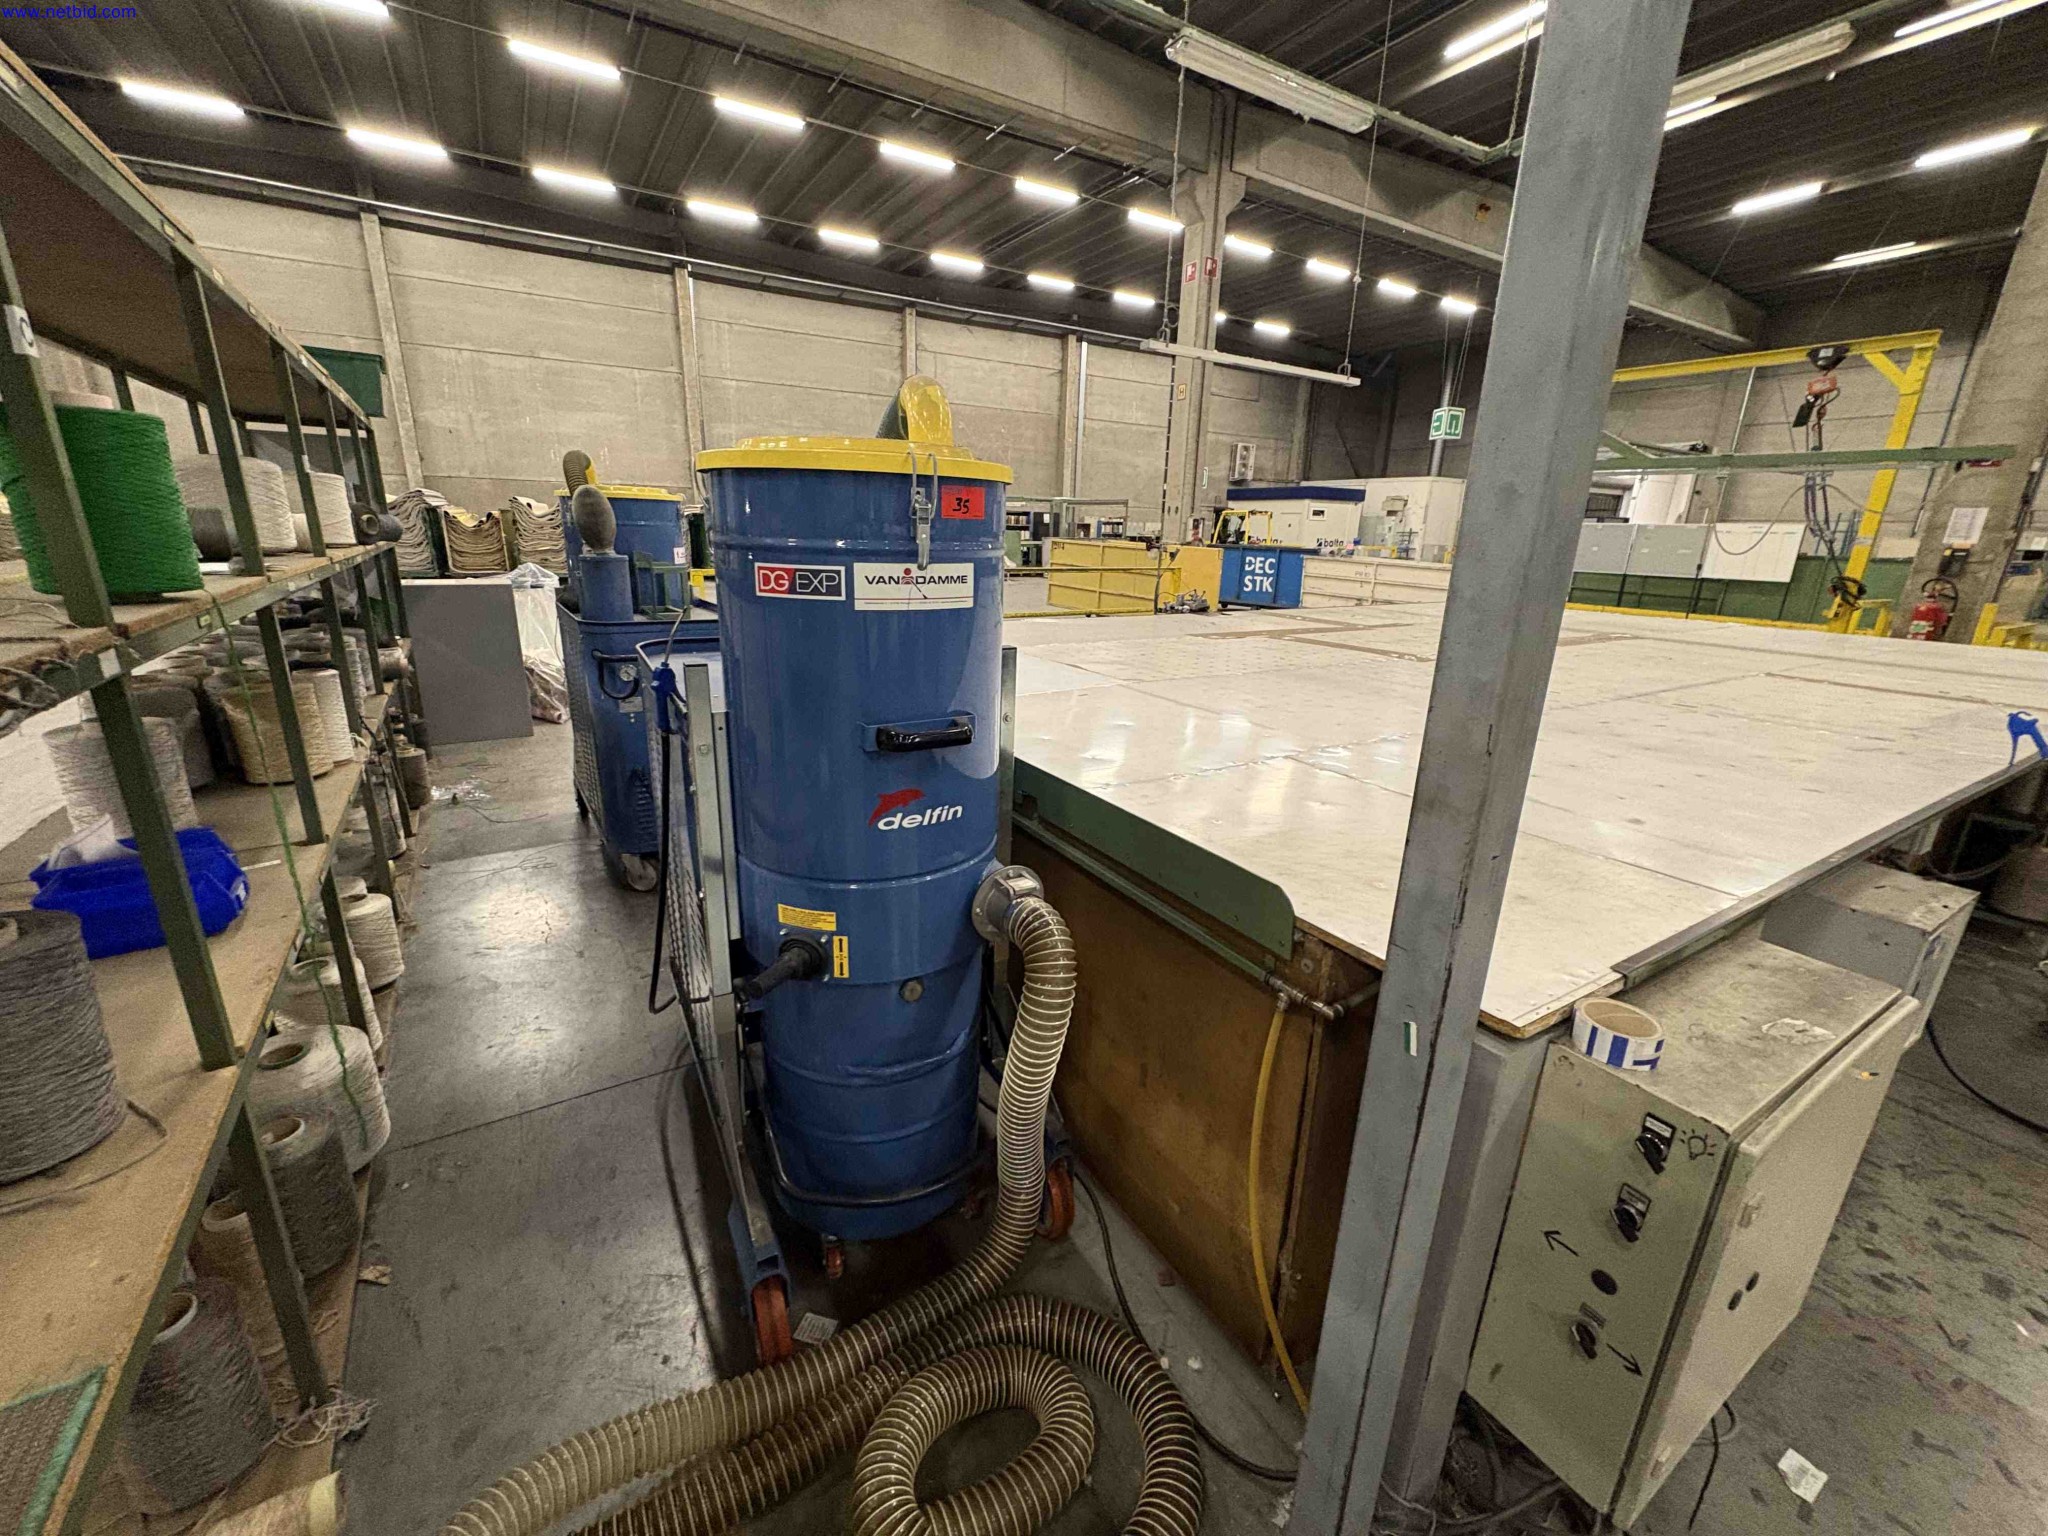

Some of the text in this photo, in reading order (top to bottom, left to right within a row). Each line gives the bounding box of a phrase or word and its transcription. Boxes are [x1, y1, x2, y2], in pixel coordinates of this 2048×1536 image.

[952, 497, 970, 515] 35
[1244, 556, 1276, 574] DEC
[759, 569, 839, 593] DG EXP
[864, 575, 968, 585] VAN DAMME
[1243, 575, 1274, 592] STK
[878, 805, 963, 830] delfin
